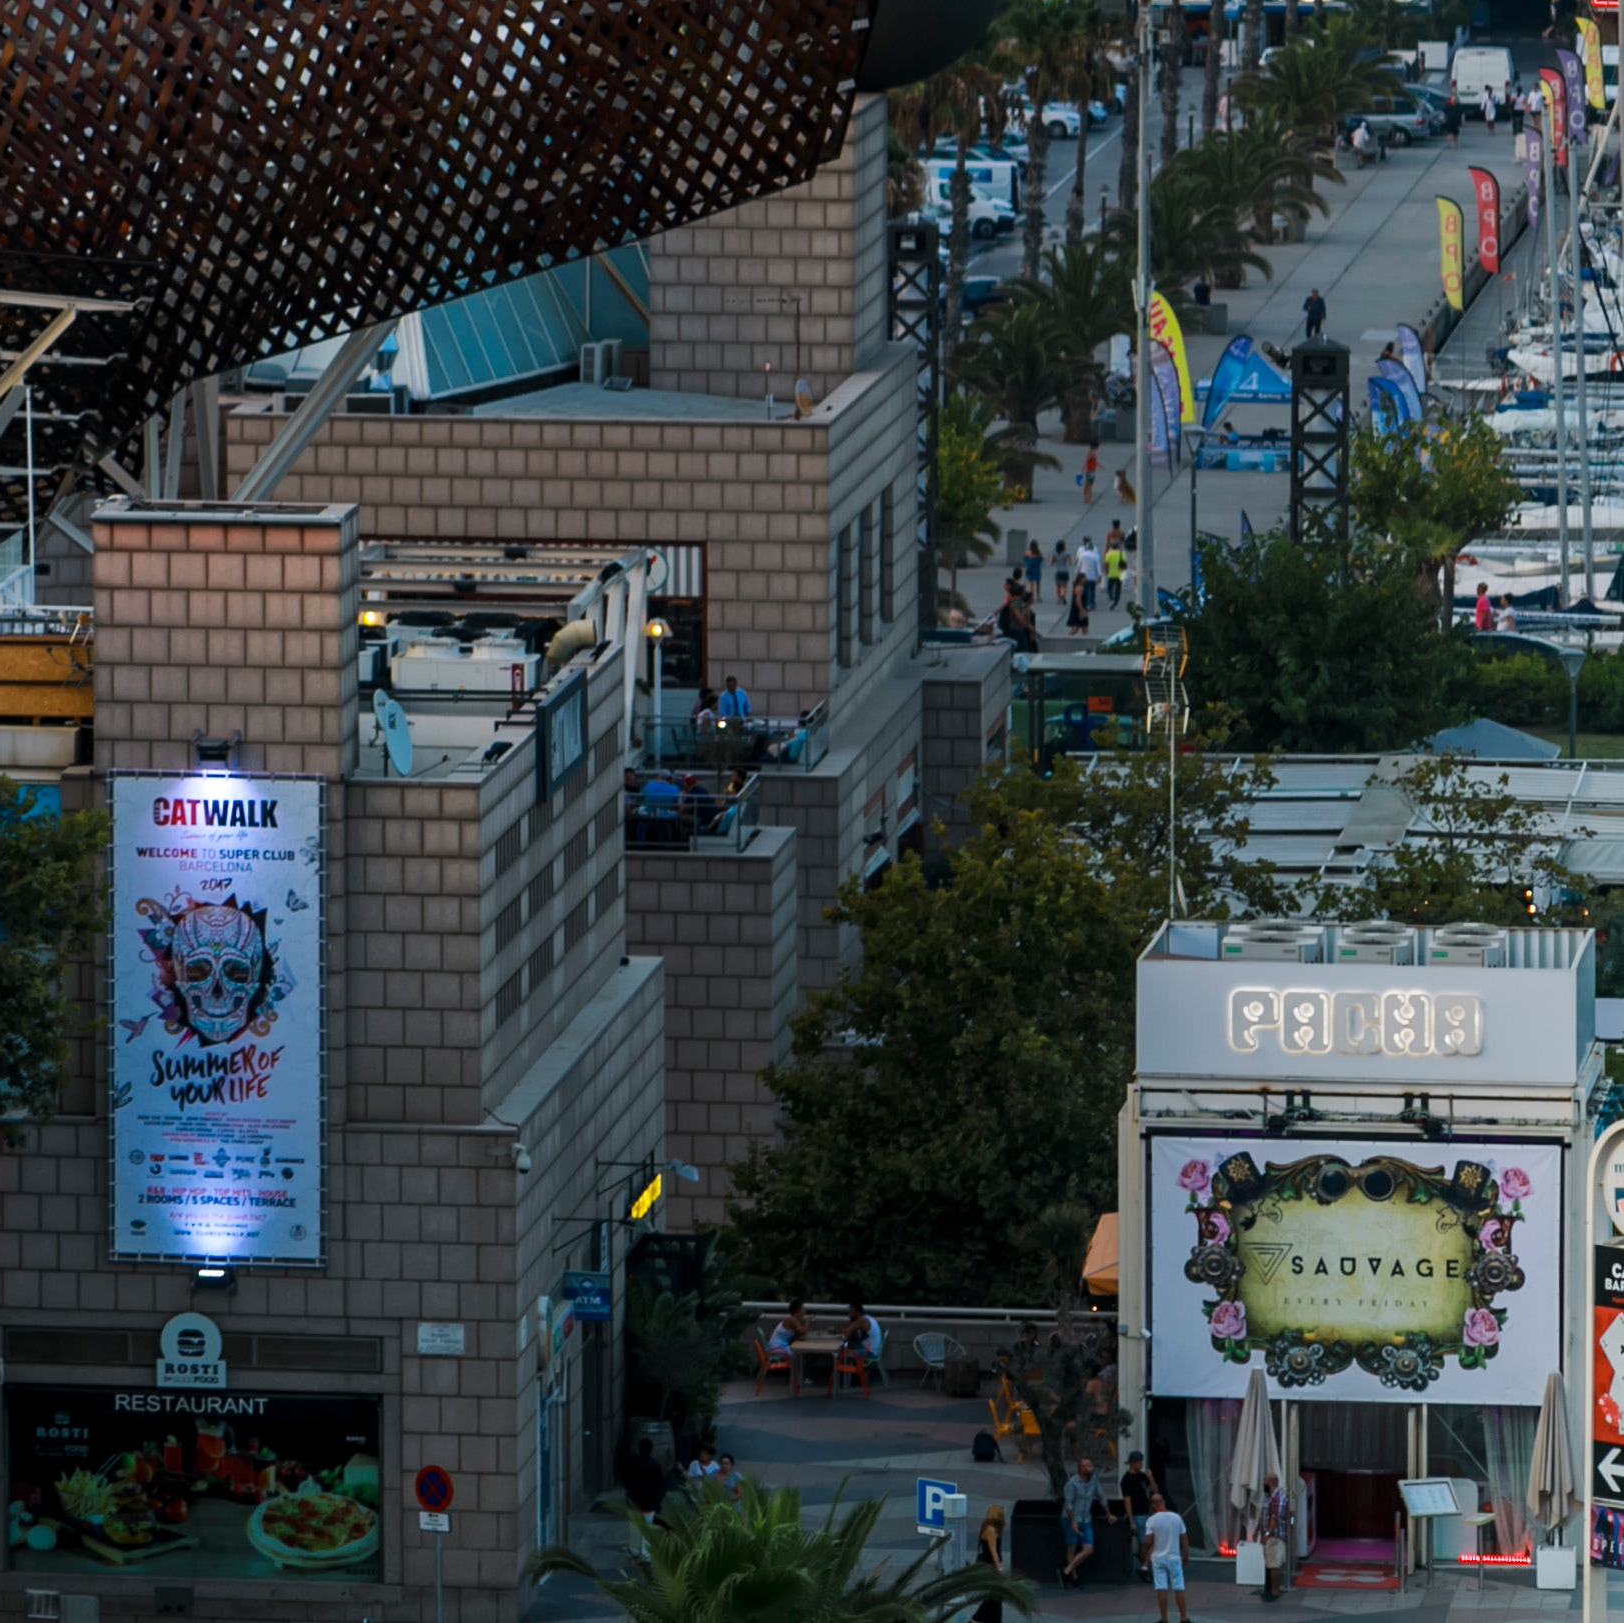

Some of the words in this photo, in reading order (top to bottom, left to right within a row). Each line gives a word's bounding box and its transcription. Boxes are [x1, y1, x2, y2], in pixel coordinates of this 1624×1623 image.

[153, 797, 278, 828] CATWALK
[136, 847, 197, 859] WELCOME
[203, 848, 216, 859] TO
[219, 849, 260, 860] SUPER
[263, 850, 296, 861] CLUB
[179, 861, 253, 872] BARCELONA
[258, 1045, 285, 1071] OF
[229, 1073, 271, 1103] LIFE
[214, 1188, 230, 1197] TOP
[138, 1194, 144, 1204] 2
[147, 1195, 183, 1205] ROOMS
[200, 1196, 240, 1206] SPACES
[249, 1197, 296, 1208] TERRACE
[1291, 1256, 1460, 1278] SAUVAGE
[574, 1296, 602, 1305] ATM
[1284, 1297, 1342, 1306] EVERY
[1358, 1298, 1428, 1307] FRIDAY
[165, 1363, 218, 1375] ROSTI
[115, 1394, 268, 1415] RESTAURANT
[36, 1426, 89, 1439] ROSTI
[925, 1485, 944, 1520] P
